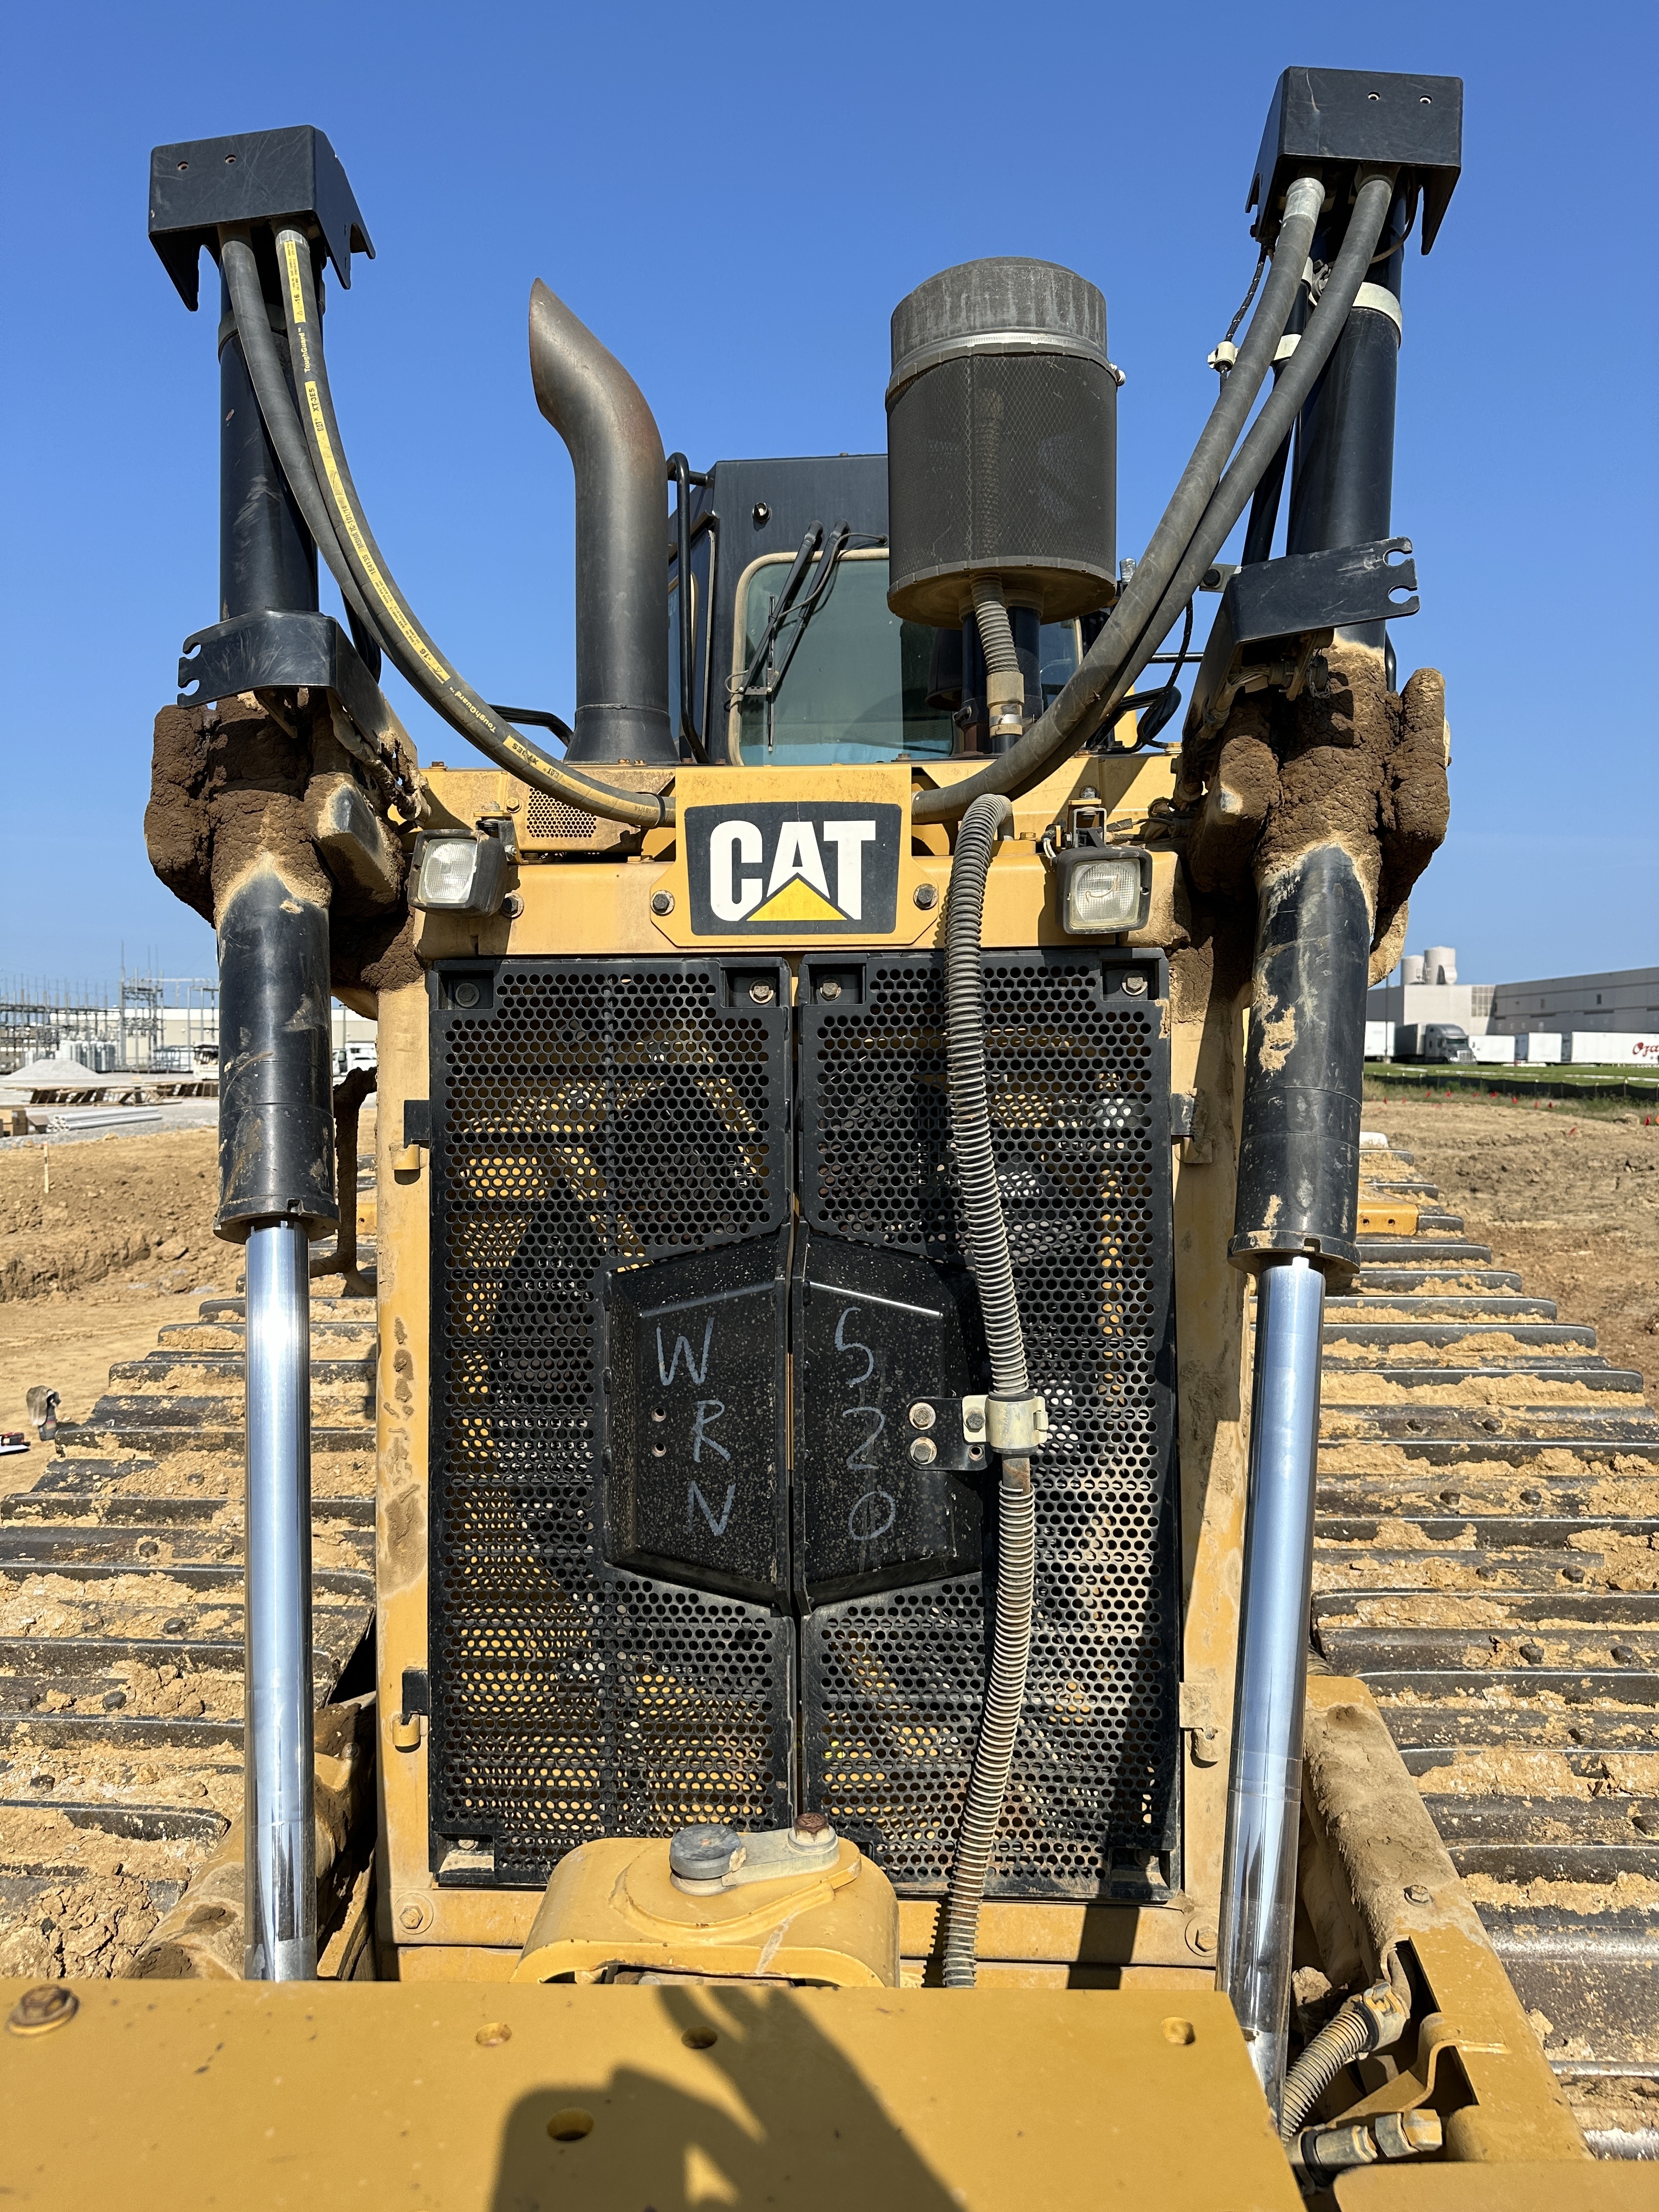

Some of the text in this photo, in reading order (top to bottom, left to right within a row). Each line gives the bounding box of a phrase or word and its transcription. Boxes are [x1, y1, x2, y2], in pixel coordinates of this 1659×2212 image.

[308, 388, 320, 412] XT-3ES
[352, 533, 364, 549] MSHA
[362, 555, 376, 575] 1E4135
[420, 648, 431, 661] -16
[709, 820, 877, 922] CAT
